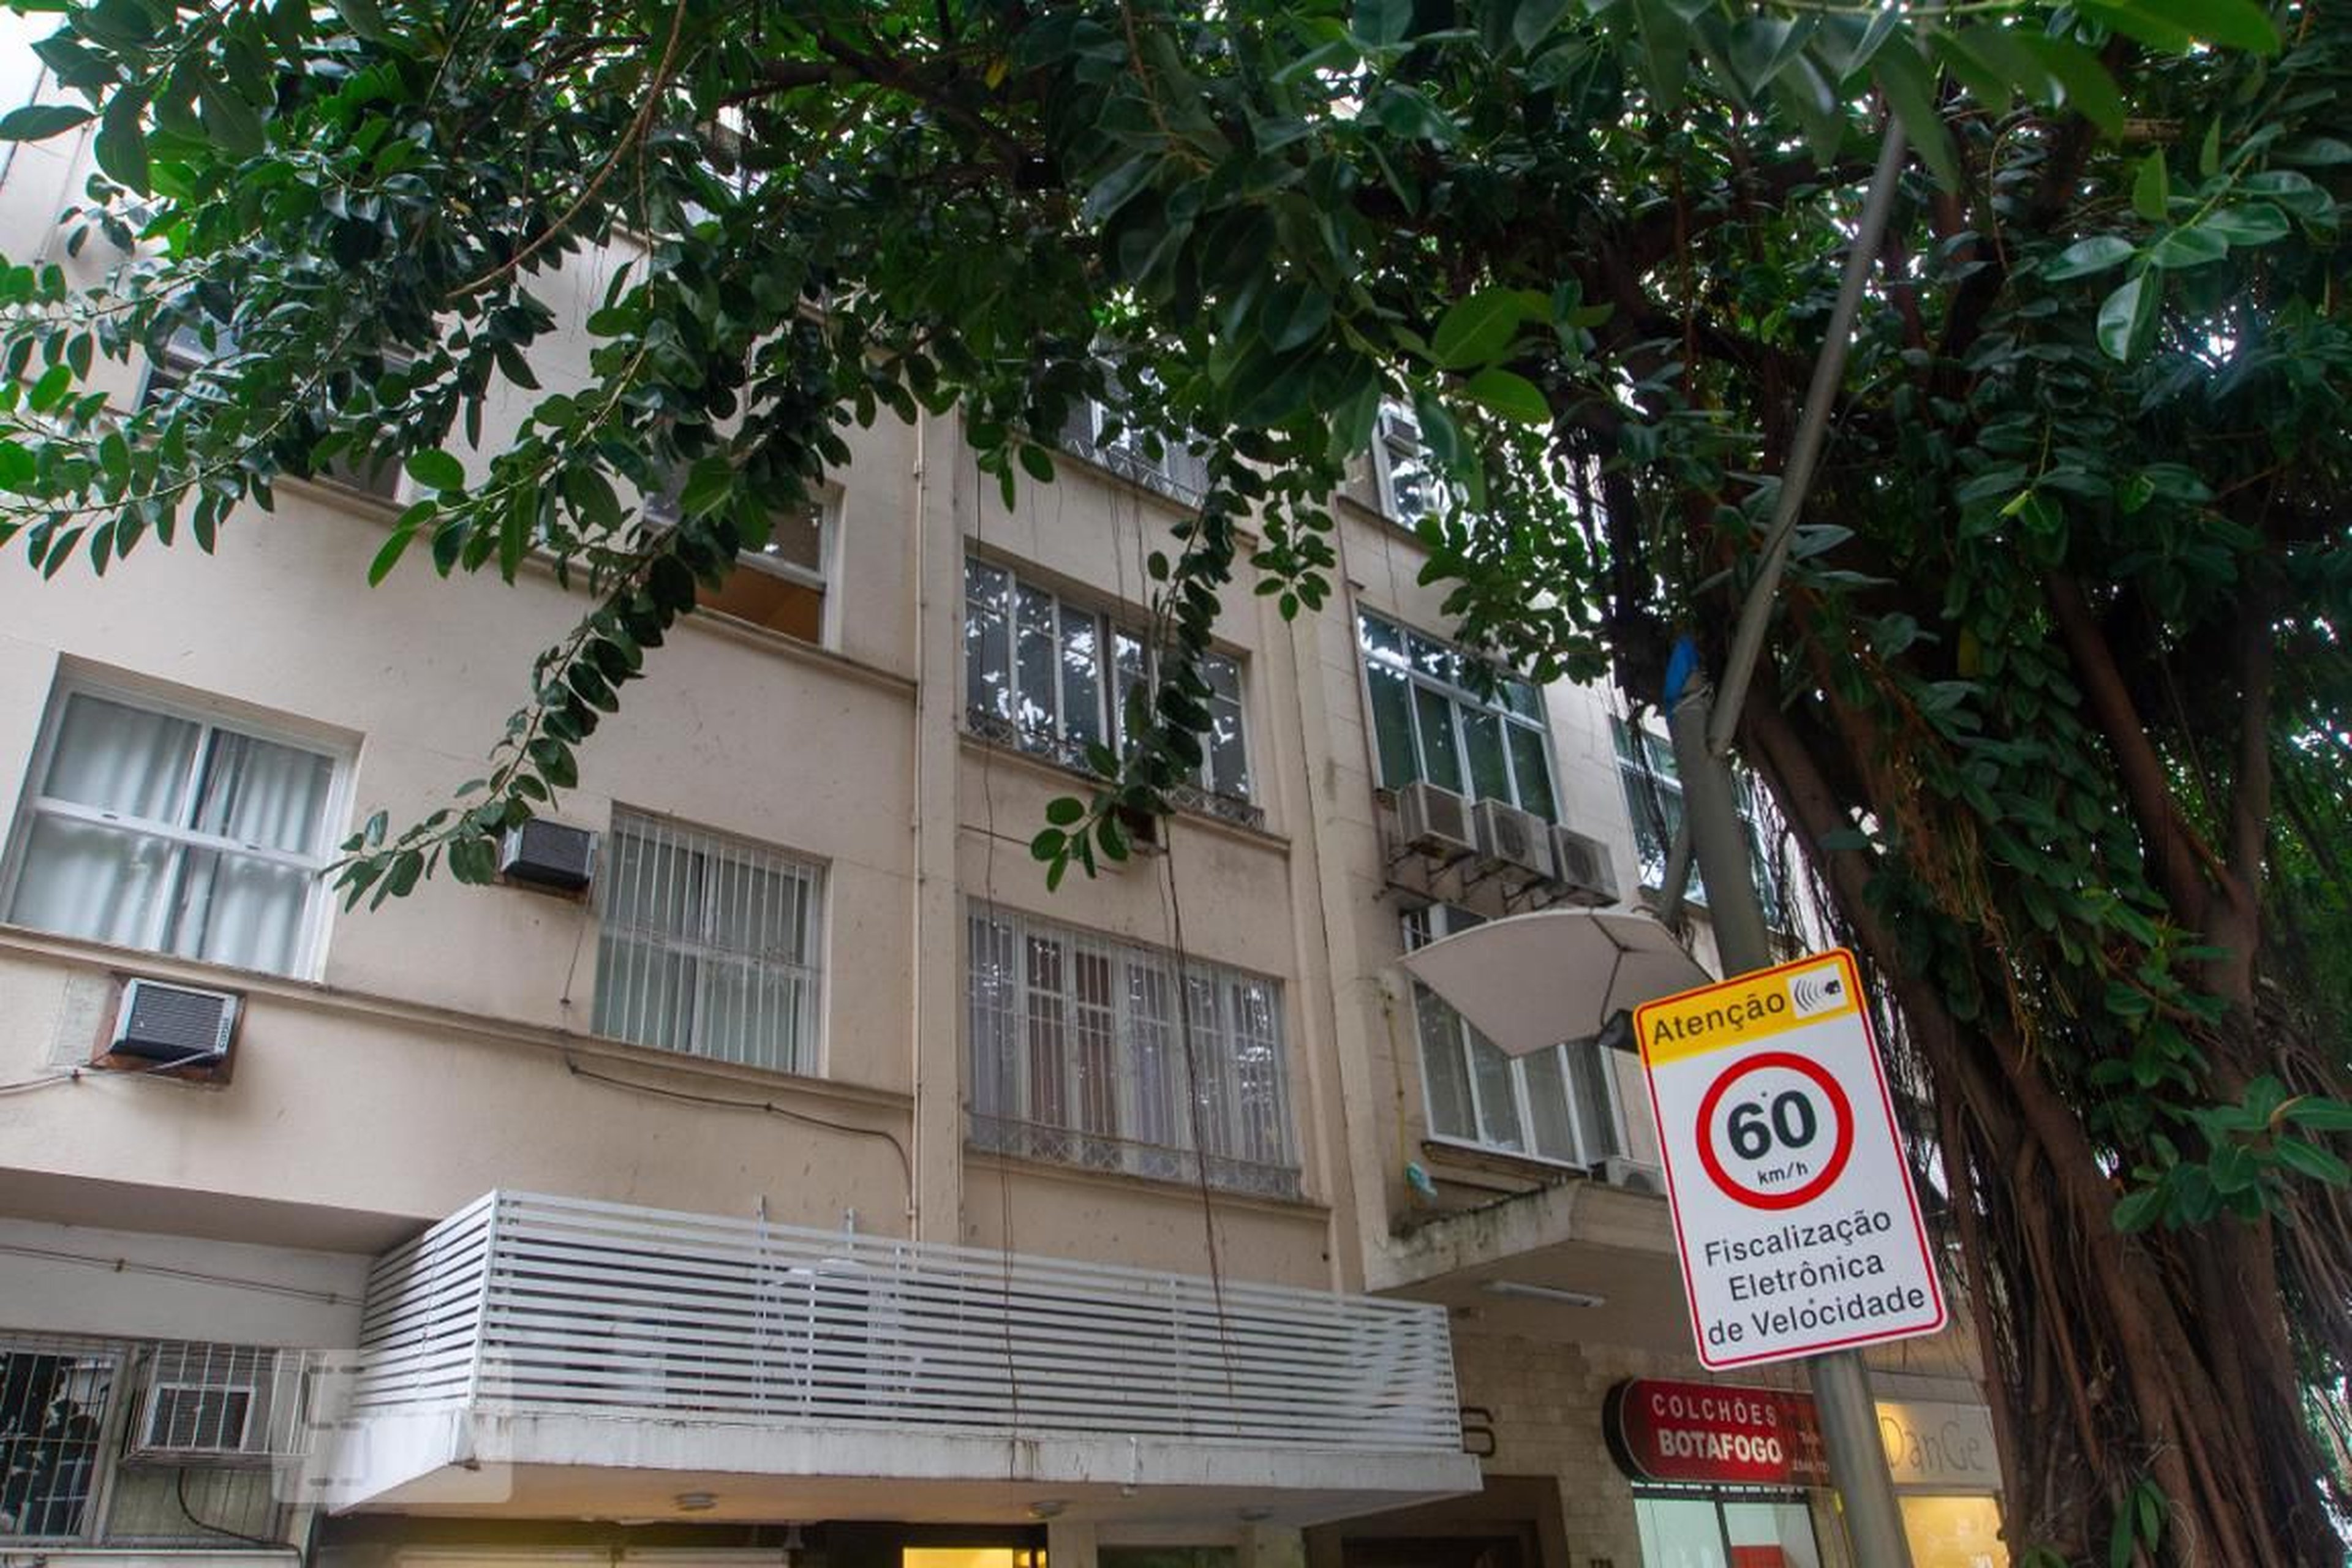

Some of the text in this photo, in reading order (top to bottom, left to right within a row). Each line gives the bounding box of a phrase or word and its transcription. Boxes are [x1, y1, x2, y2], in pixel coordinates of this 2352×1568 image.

[1653, 990, 1785, 1045] Atenção
[1727, 1090, 1817, 1160] 60
[1758, 1162, 1808, 1186] km/h
[1705, 1210, 1891, 1267] Fiscalização
[1728, 1252, 1885, 1302] Eletrônica
[1708, 1286, 1925, 1346] de Velocidade
[1652, 1394, 1777, 1427] COLCHÕES
[1657, 1428, 1783, 1464] BOTAFOGO
